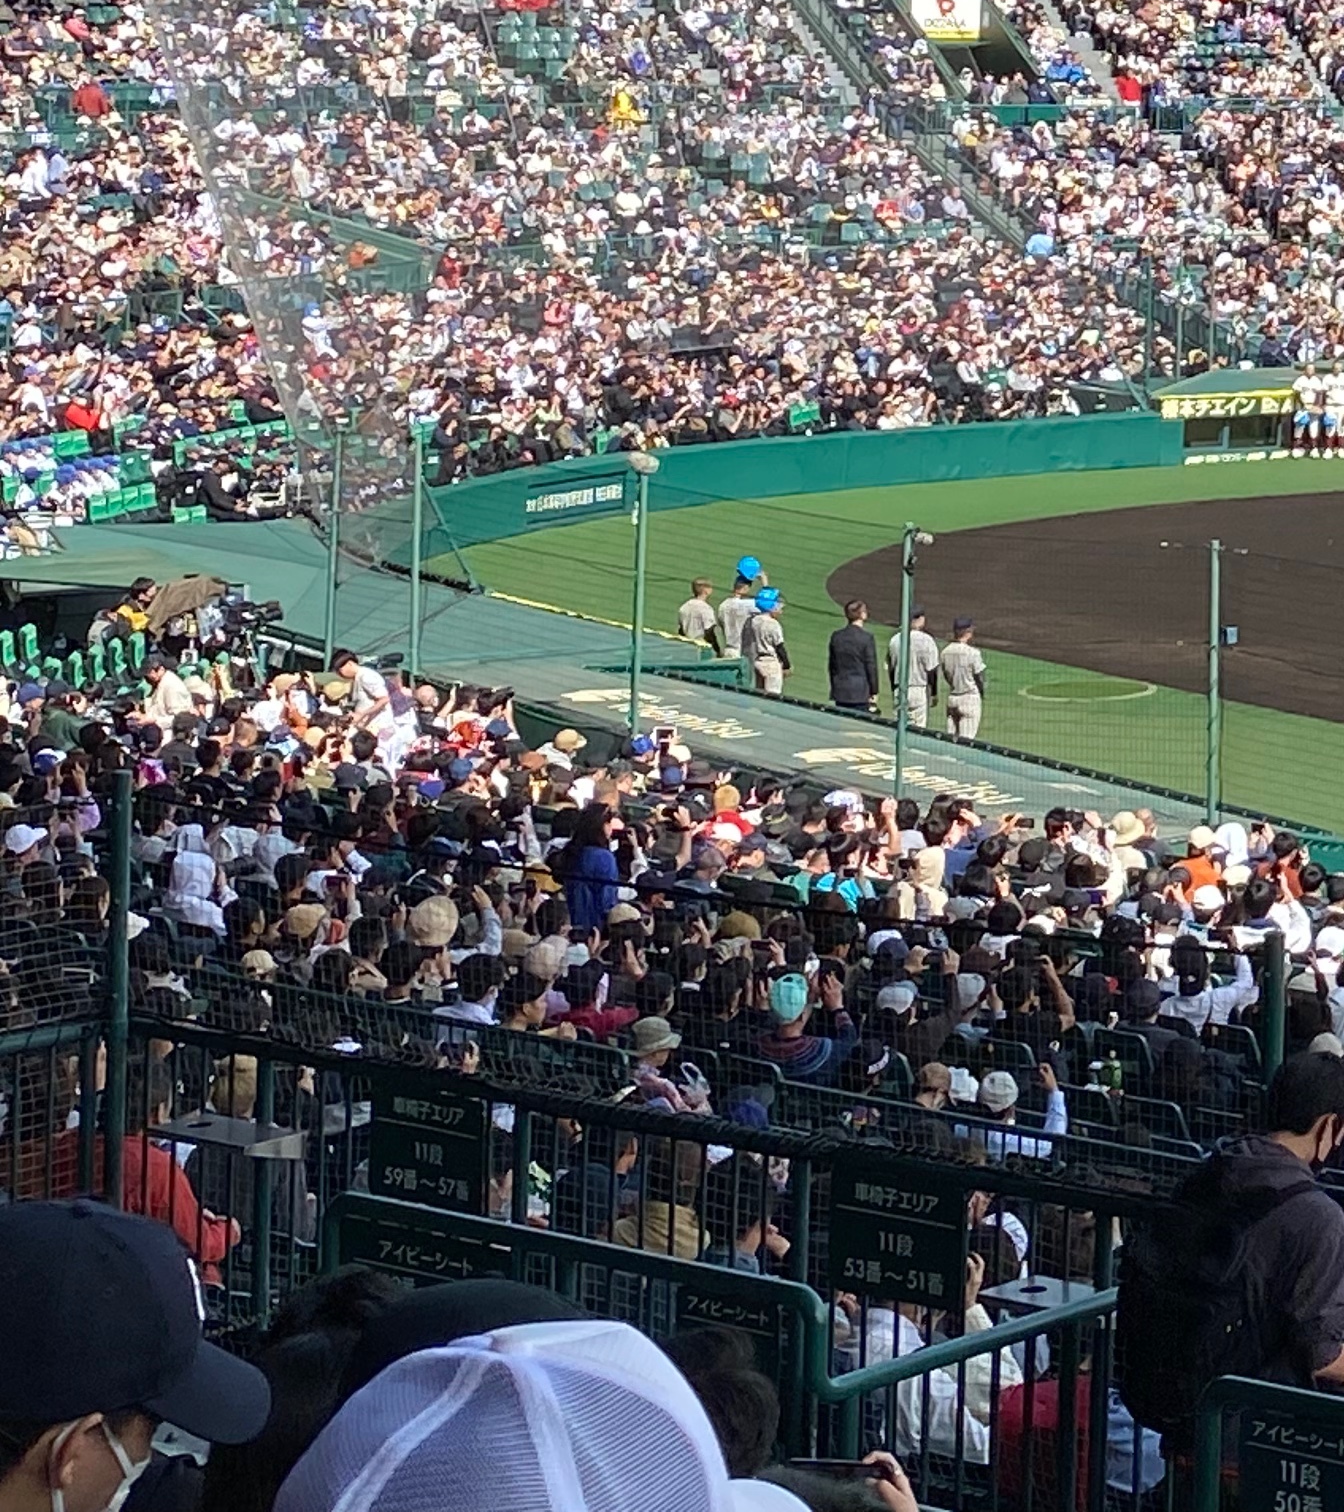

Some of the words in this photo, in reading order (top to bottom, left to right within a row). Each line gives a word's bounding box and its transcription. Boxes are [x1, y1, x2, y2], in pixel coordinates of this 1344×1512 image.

[377, 1238, 473, 1277] アイビーシート
[878, 1230, 915, 1259] 11段
[685, 1294, 771, 1325] アイビーシート
[1280, 1459, 1321, 1492] 11段
